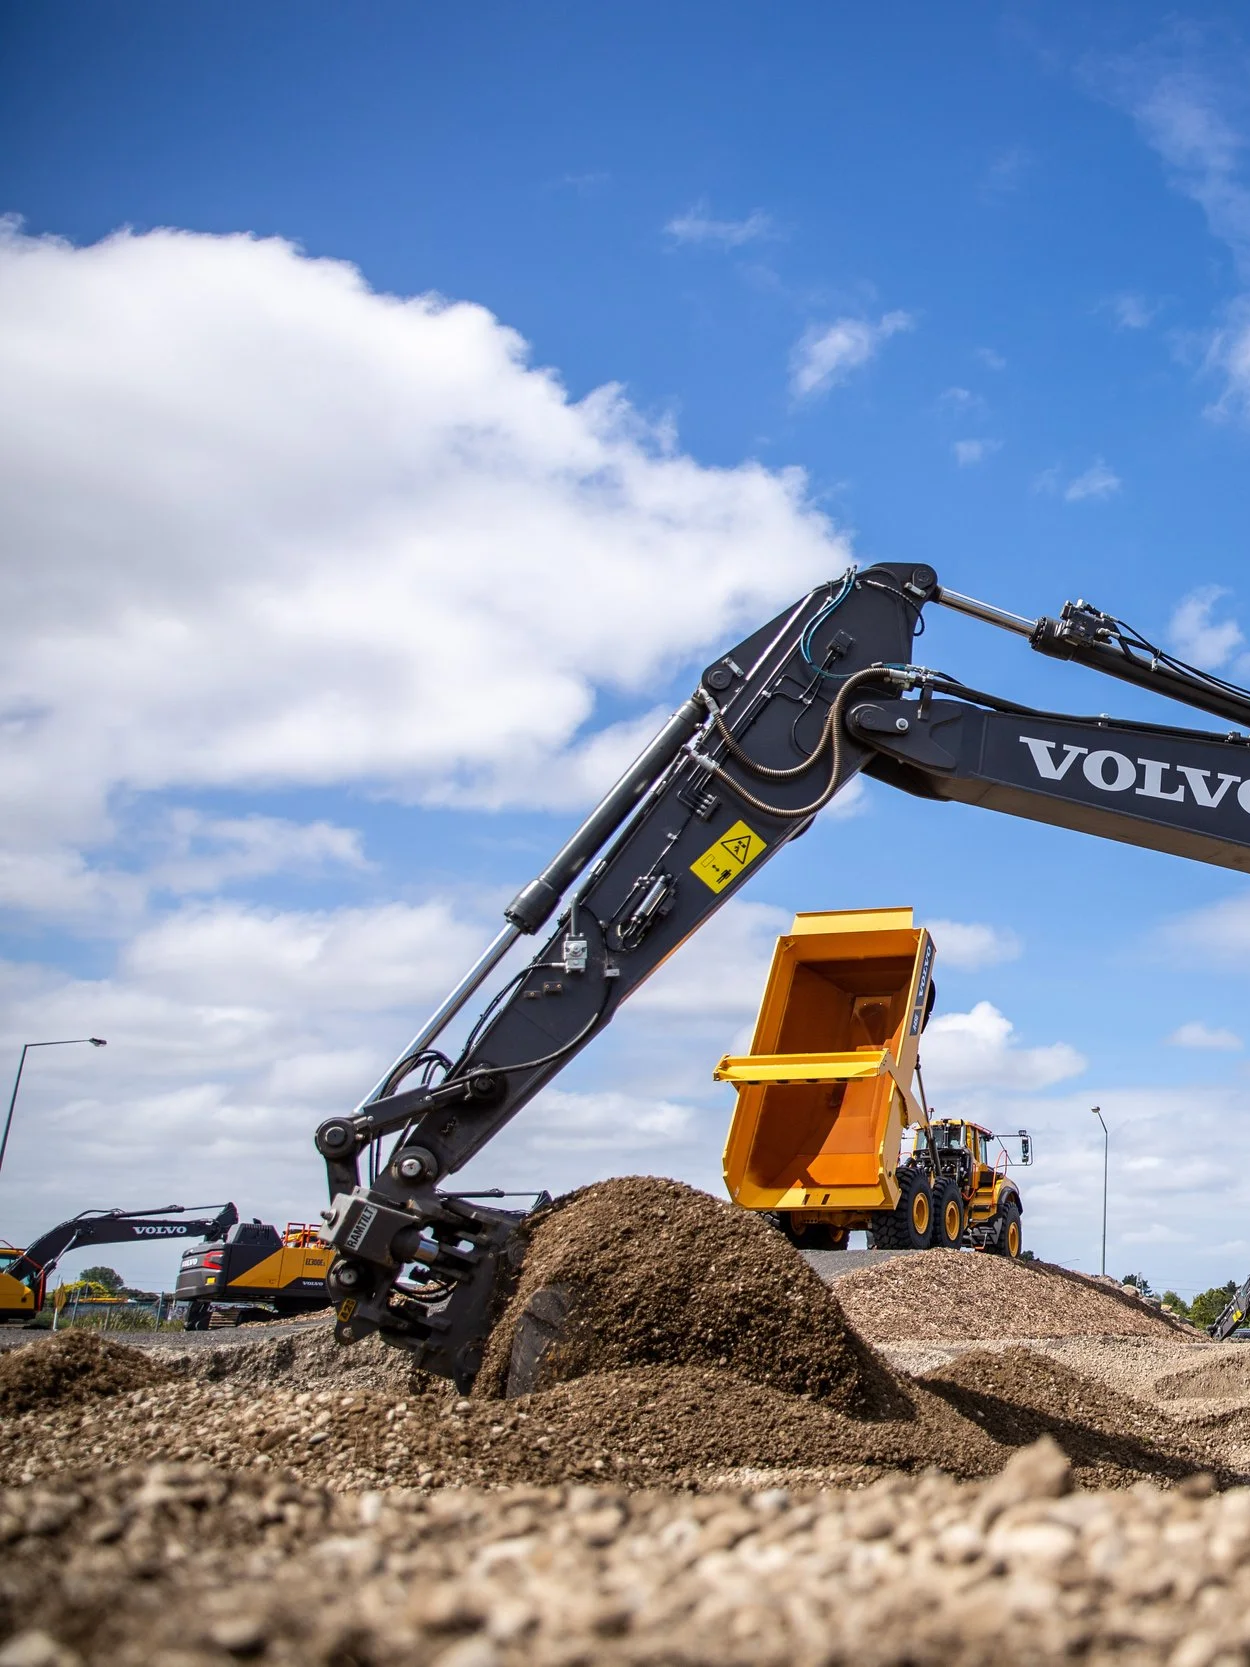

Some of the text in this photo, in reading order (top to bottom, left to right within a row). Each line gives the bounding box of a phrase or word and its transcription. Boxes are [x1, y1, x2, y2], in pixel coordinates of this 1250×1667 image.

[918, 945, 931, 997] VOLVO
[132, 1226, 187, 1235] VOLVO
[347, 1206, 374, 1249] RAMTILT
